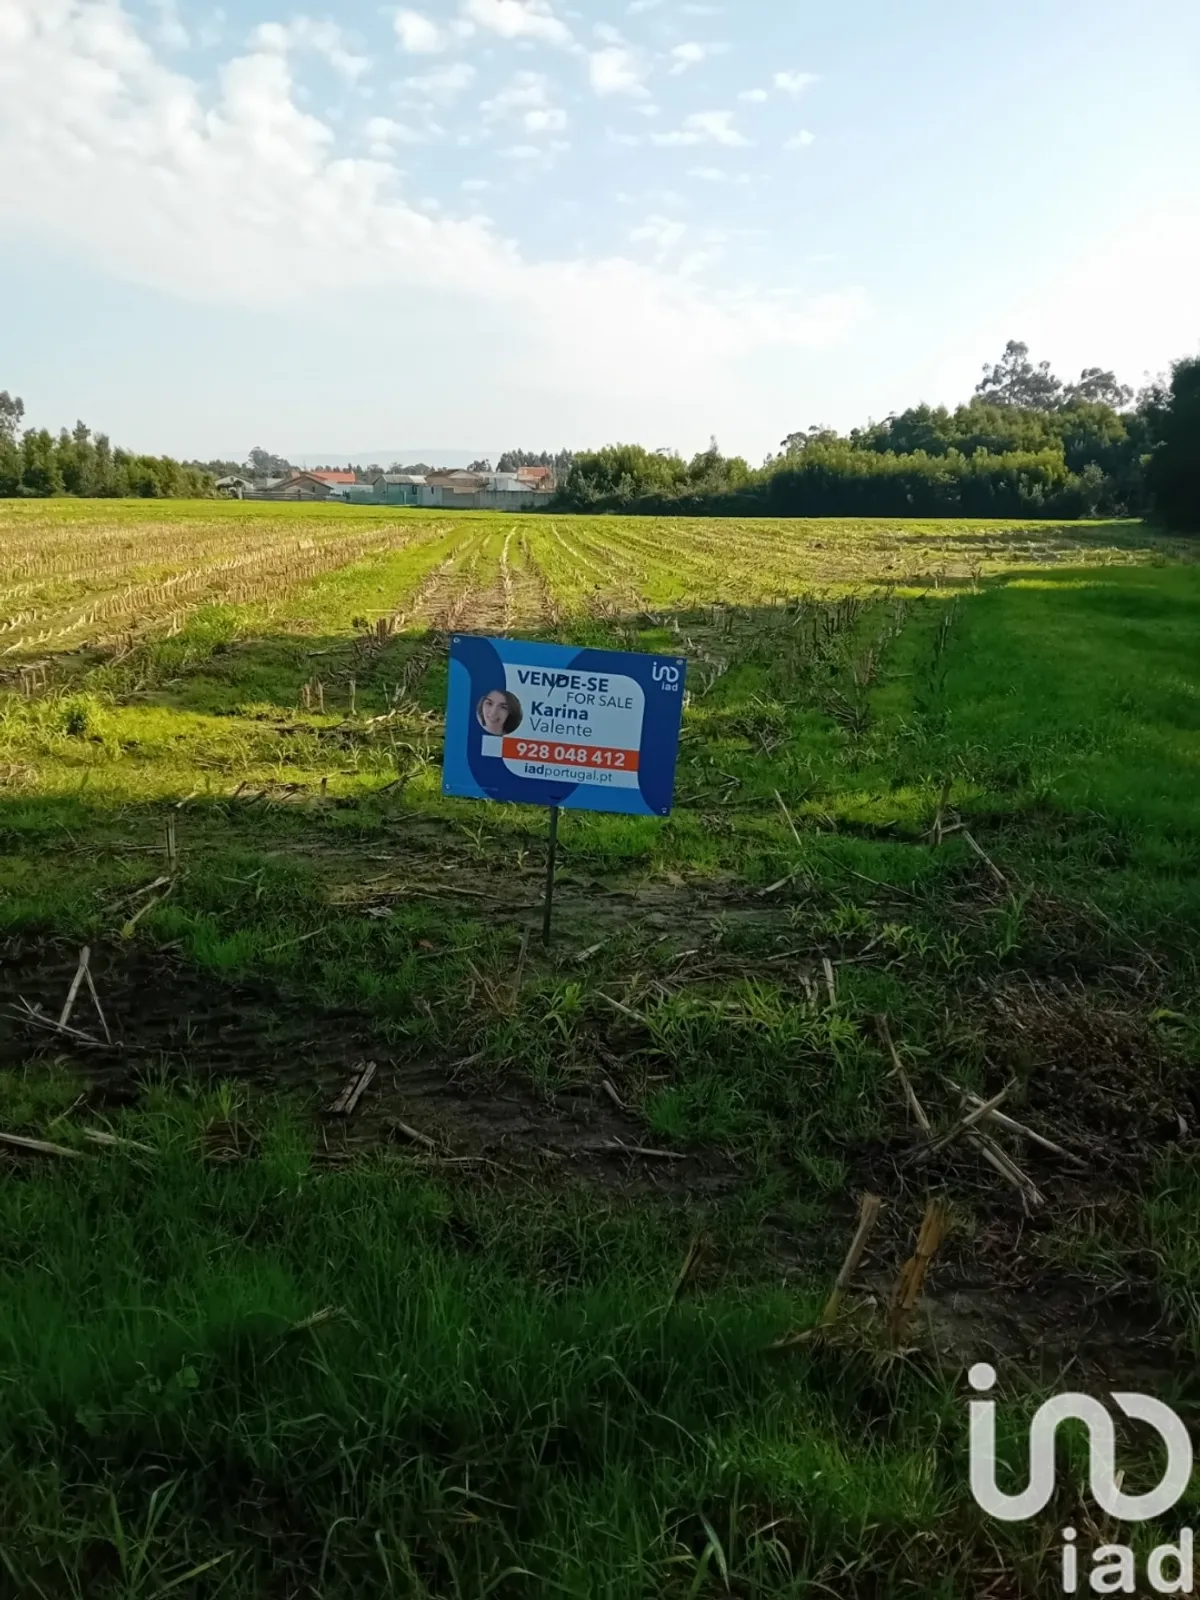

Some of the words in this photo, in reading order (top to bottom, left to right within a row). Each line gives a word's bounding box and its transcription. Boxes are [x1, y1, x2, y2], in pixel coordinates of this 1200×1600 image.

[517, 670, 609, 692] VENDE-SE
[661, 682, 679, 691] iad
[567, 692, 595, 705] FOR
[599, 695, 633, 709] SALE
[530, 701, 588, 720] Karina
[529, 717, 592, 737] Valente
[516, 742, 549, 758] 928
[554, 746, 587, 762] 048
[591, 751, 625, 766] 412
[524, 763, 612, 782] iadportugal.pt
